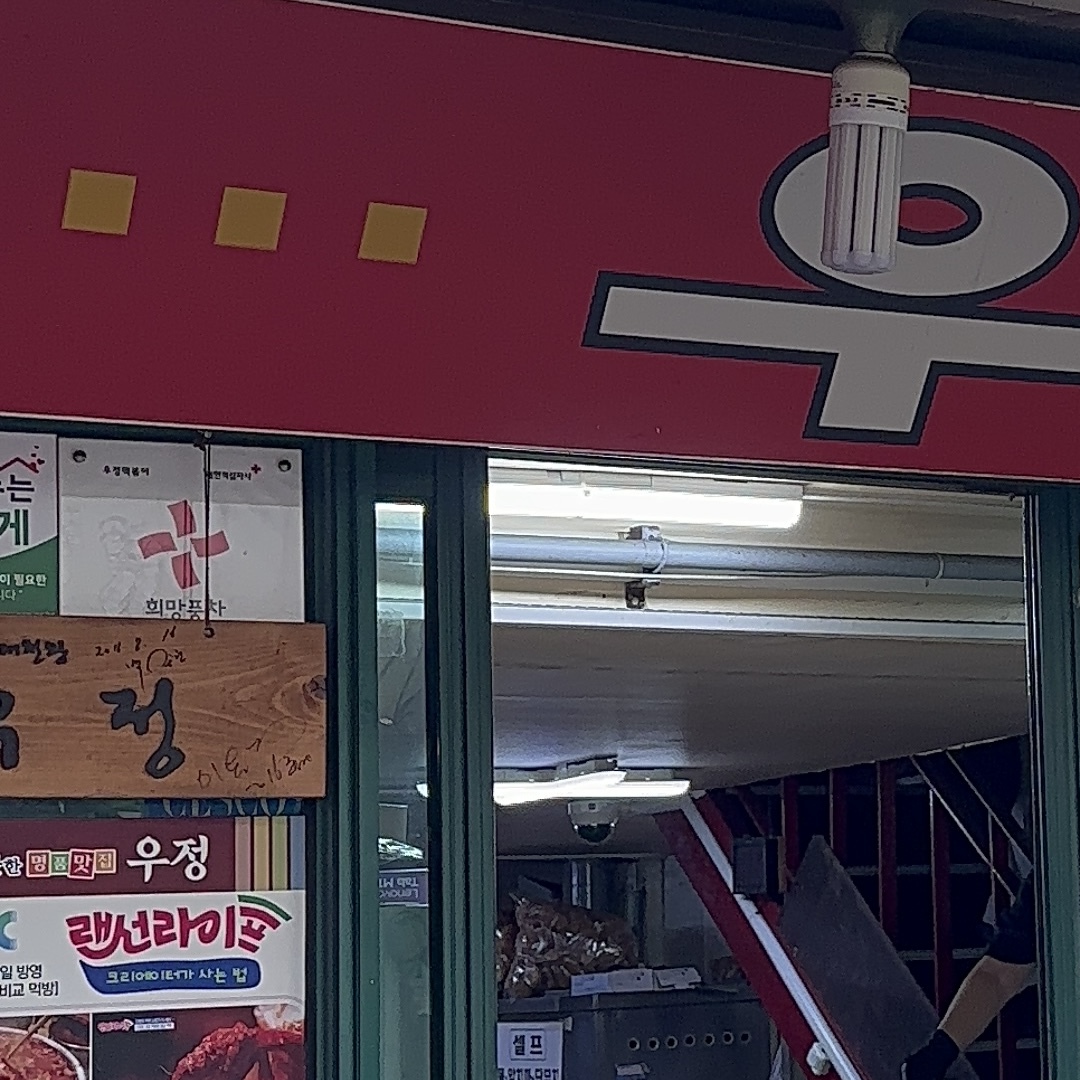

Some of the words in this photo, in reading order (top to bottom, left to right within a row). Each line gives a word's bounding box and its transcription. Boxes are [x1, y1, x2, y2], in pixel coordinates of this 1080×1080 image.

[0, 474, 35, 503] 는
[146, 597, 226, 621] 희망풍차
[0, 856, 23, 878] 한
[126, 835, 208, 883] 우정
[66, 904, 282, 960] 랜선라이프
[16, 964, 42, 980] 방영
[198, 967, 227, 985] 사는
[232, 966, 248, 983] 법
[513, 1034, 543, 1056] 셀프
